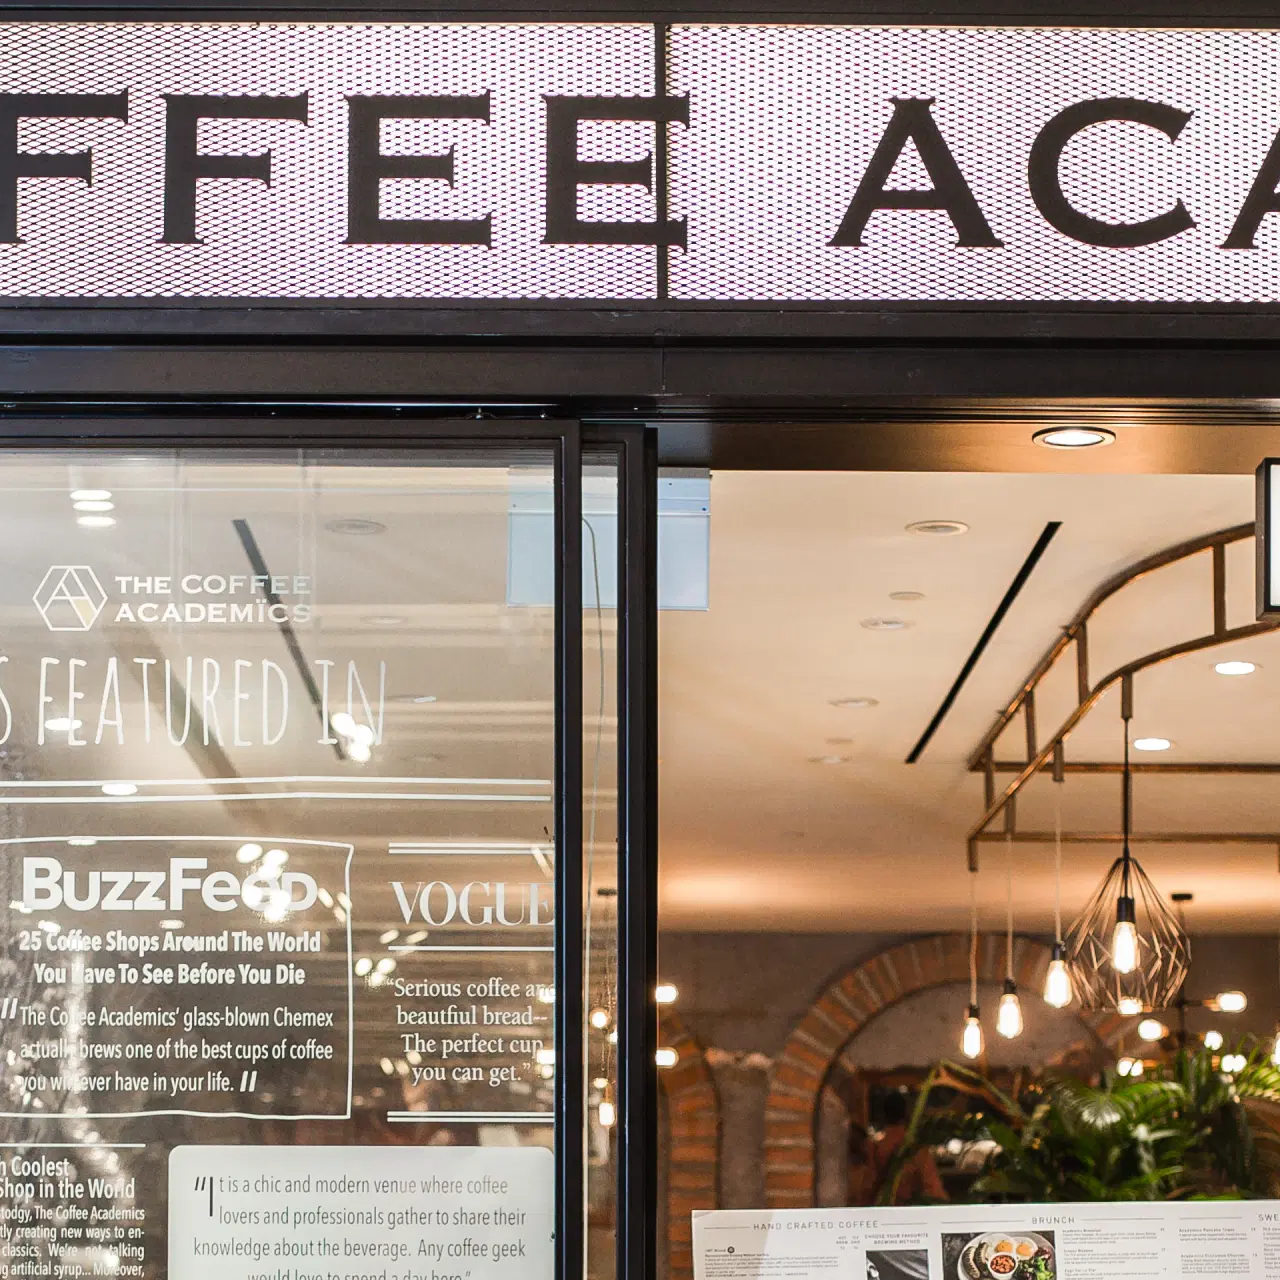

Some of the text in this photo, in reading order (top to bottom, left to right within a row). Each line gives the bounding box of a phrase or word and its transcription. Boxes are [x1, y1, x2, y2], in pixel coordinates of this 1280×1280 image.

[115, 575, 311, 595] THE COFFEE
[38, 656, 289, 746] FEATURED
[315, 659, 386, 746] IN
[388, 881, 555, 926] VOGUE
[20, 930, 320, 956] 25 Coffee Shops Around The World
[34, 964, 66, 984] You
[119, 964, 139, 984] To
[142, 964, 173, 984] See
[178, 964, 235, 984] Before
[238, 964, 271, 984] You
[276, 964, 305, 984] Die
[467, 977, 520, 997] coffee
[184, 1007, 269, 1031] glass-blown
[273, 1006, 333, 1027] Chemex
[401, 1033, 544, 1058] The perfect cup
[412, 1066, 446, 1085] you
[452, 1066, 484, 1080] can
[12, 1156, 69, 1177] Coolest
[40, 1179, 53, 1198] in
[59, 1179, 83, 1199] the
[228, 1178, 239, 1193] is
[243, 1181, 250, 1193] a
[254, 1176, 282, 1193] chic
[285, 1176, 310, 1193] and
[316, 1176, 369, 1193] modern
[374, 1181, 416, 1194] venue
[421, 1176, 462, 1194] where
[467, 1176, 508, 1194] coffee
[220, 1206, 526, 1230] lovers and professionals gather to share their
[753, 1220, 878, 1231] HAND CRAFTED COFFEE
[1032, 1216, 1075, 1225] BRUNCH
